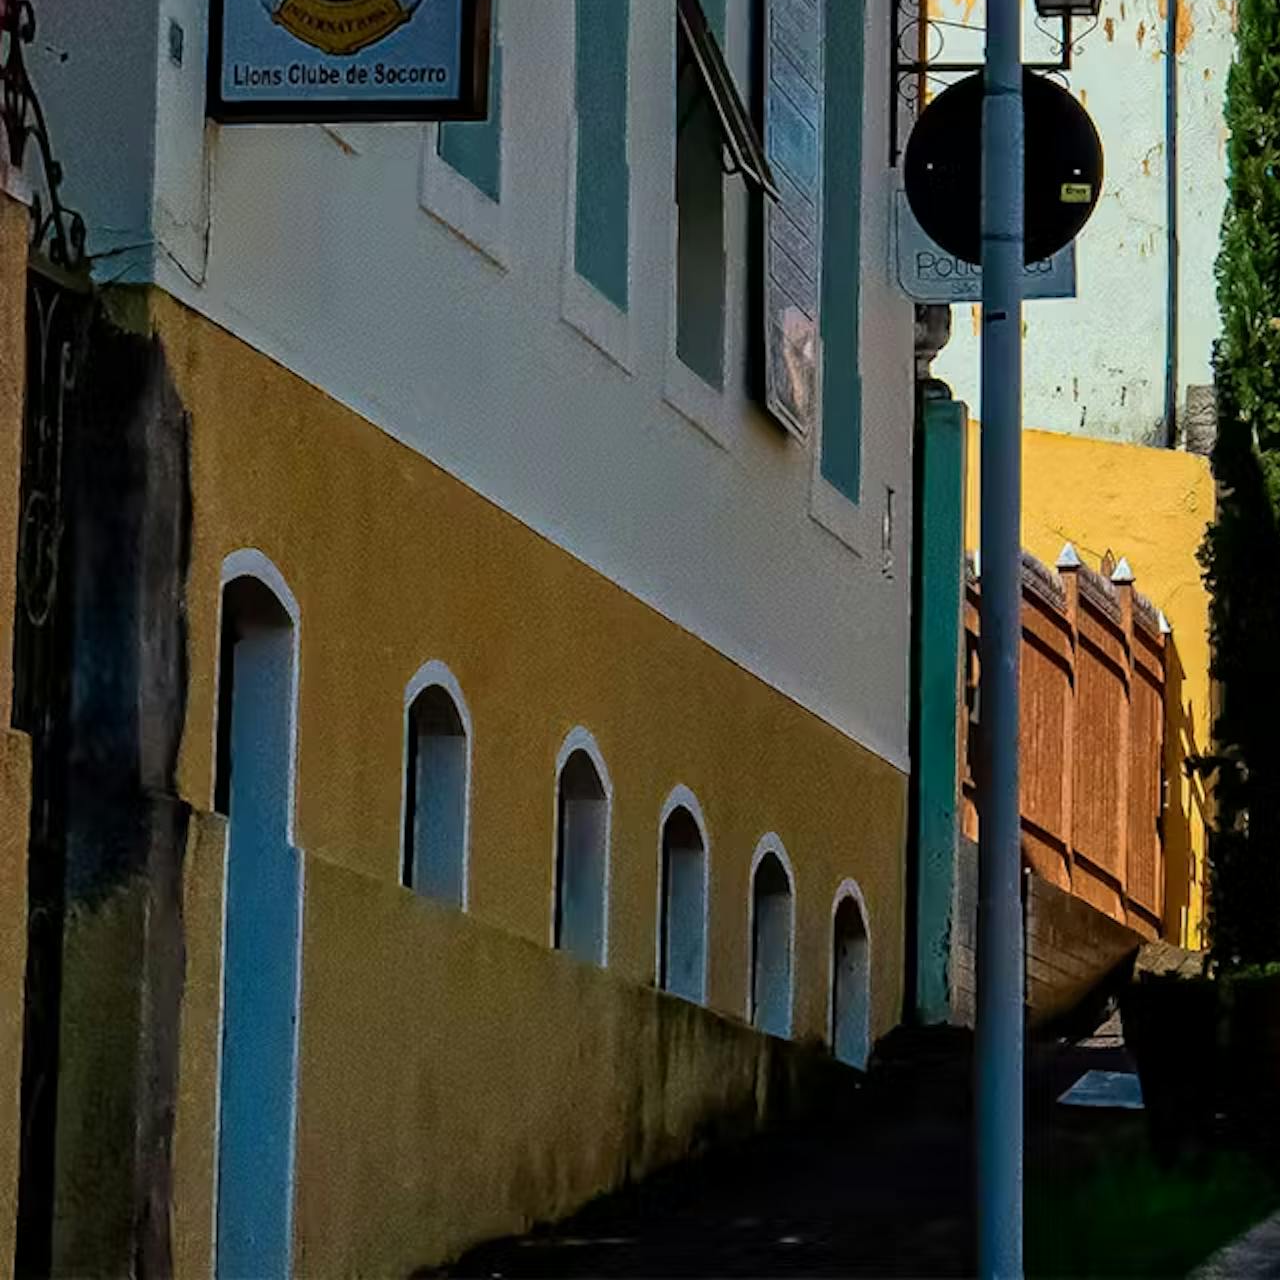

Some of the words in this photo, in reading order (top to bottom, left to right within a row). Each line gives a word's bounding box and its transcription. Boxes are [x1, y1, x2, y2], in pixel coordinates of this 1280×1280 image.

[234, 65, 282, 86] Lions
[288, 64, 340, 85] Clube
[346, 63, 368, 83] de
[374, 63, 446, 83] Socorro
